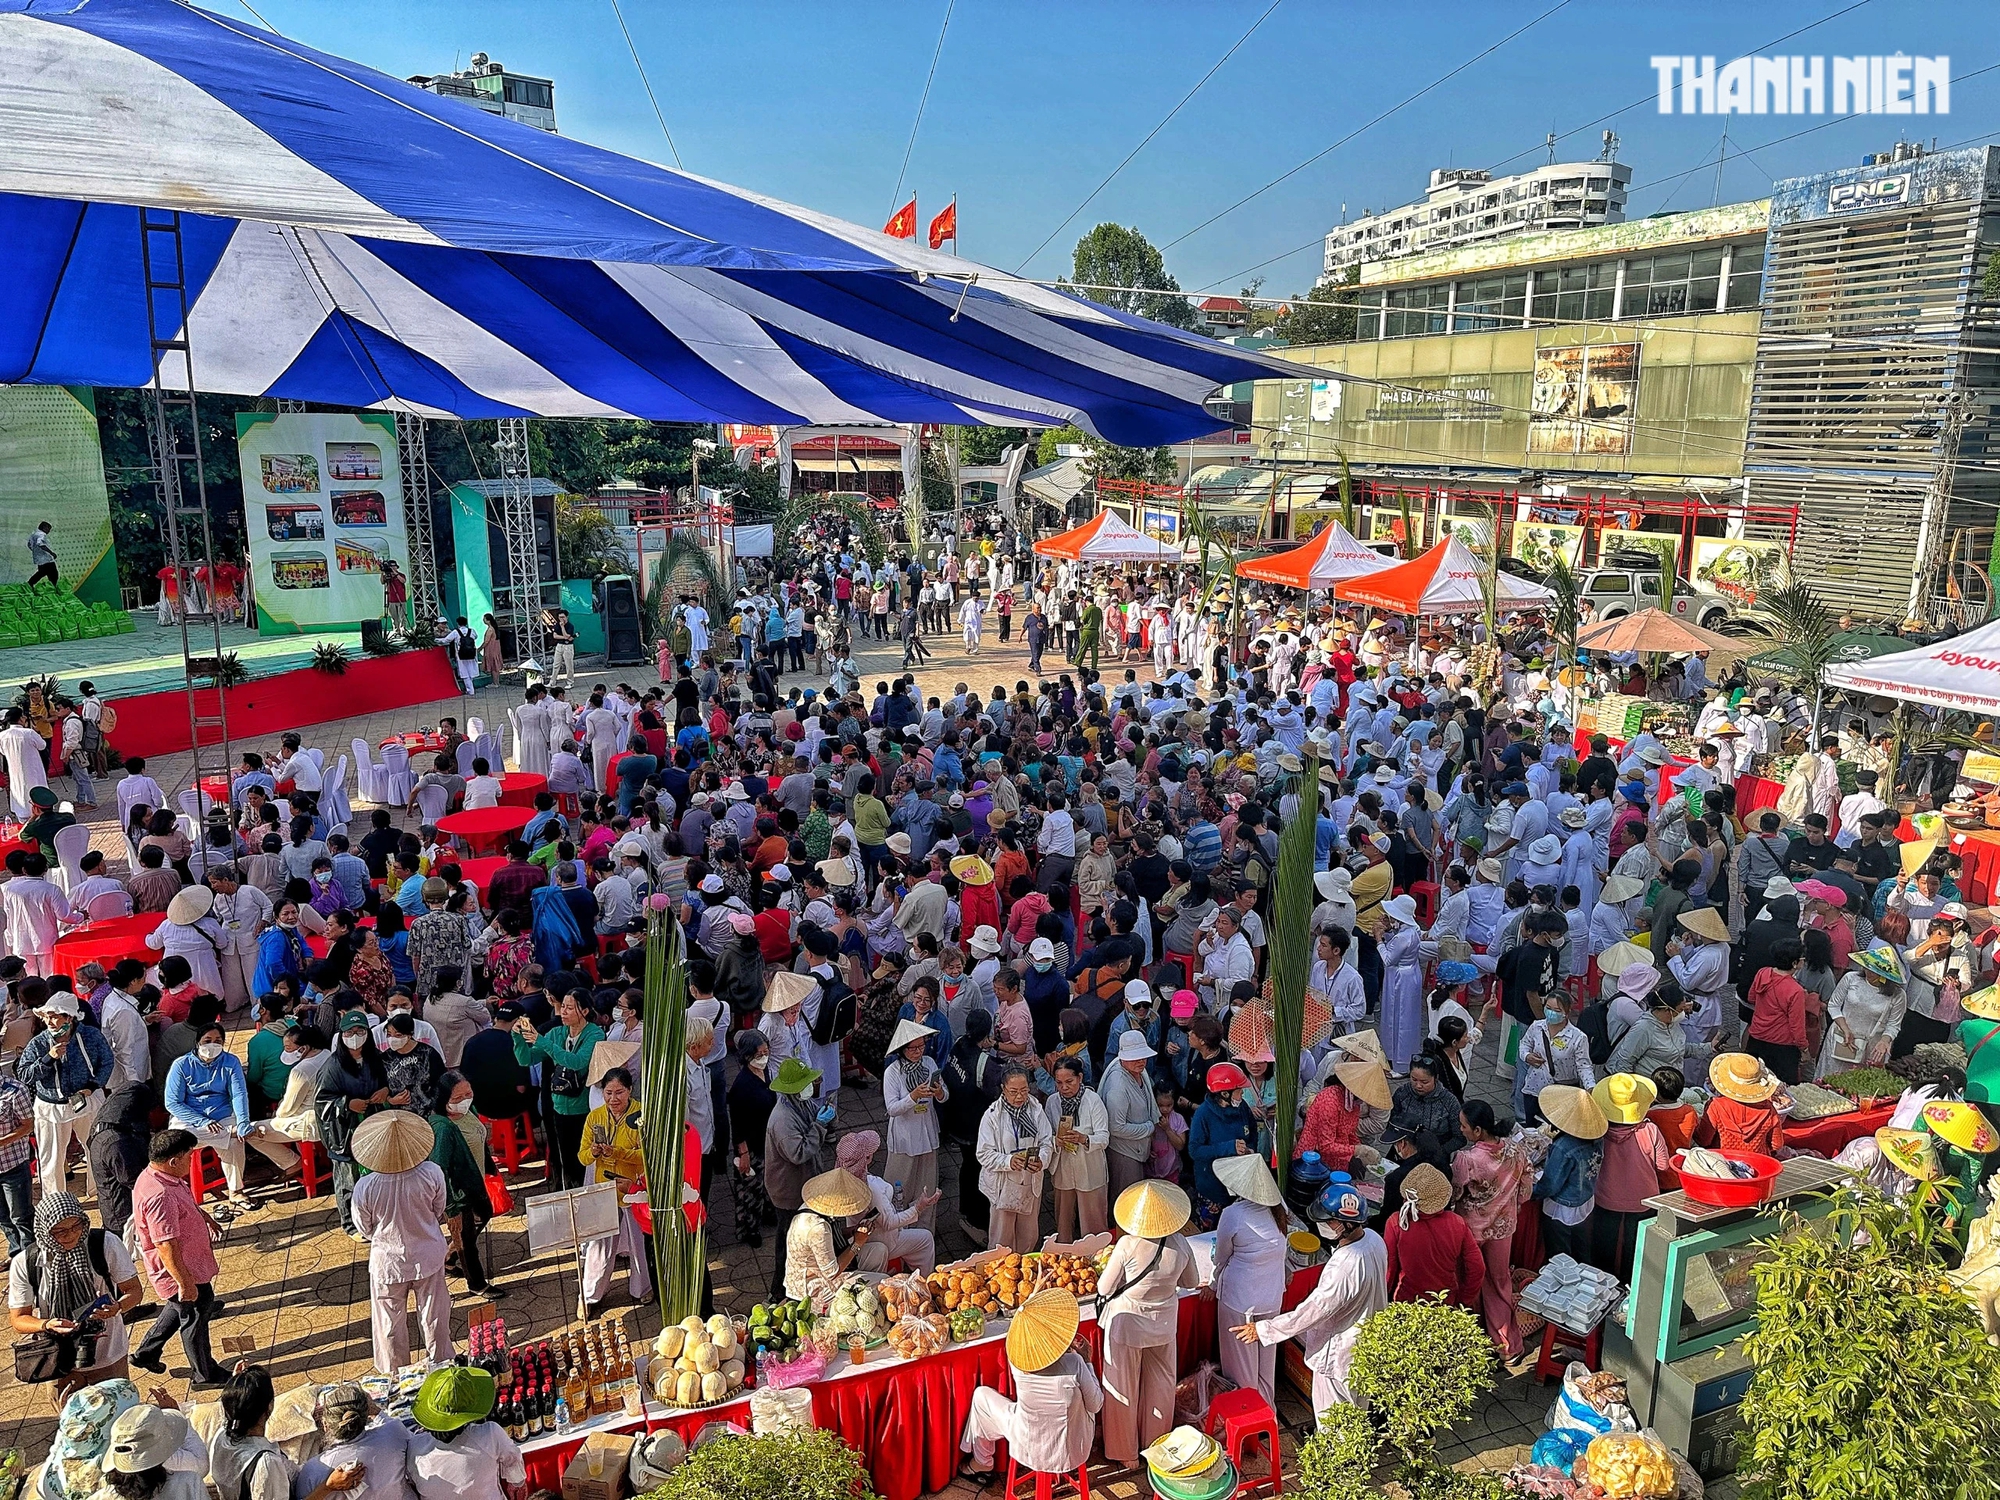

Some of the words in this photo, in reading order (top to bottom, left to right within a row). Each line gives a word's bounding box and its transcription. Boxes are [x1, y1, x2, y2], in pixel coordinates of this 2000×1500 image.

[1831, 176, 1905, 205] PNC
[1466, 387, 1490, 402] NAM
[1333, 552, 1376, 560] Joyoung
[1442, 602, 1465, 611] Joyoung
[1930, 650, 2000, 675] Joyoun
[1848, 676, 1883, 690] Joyoung
[1931, 689, 1954, 702] Công
